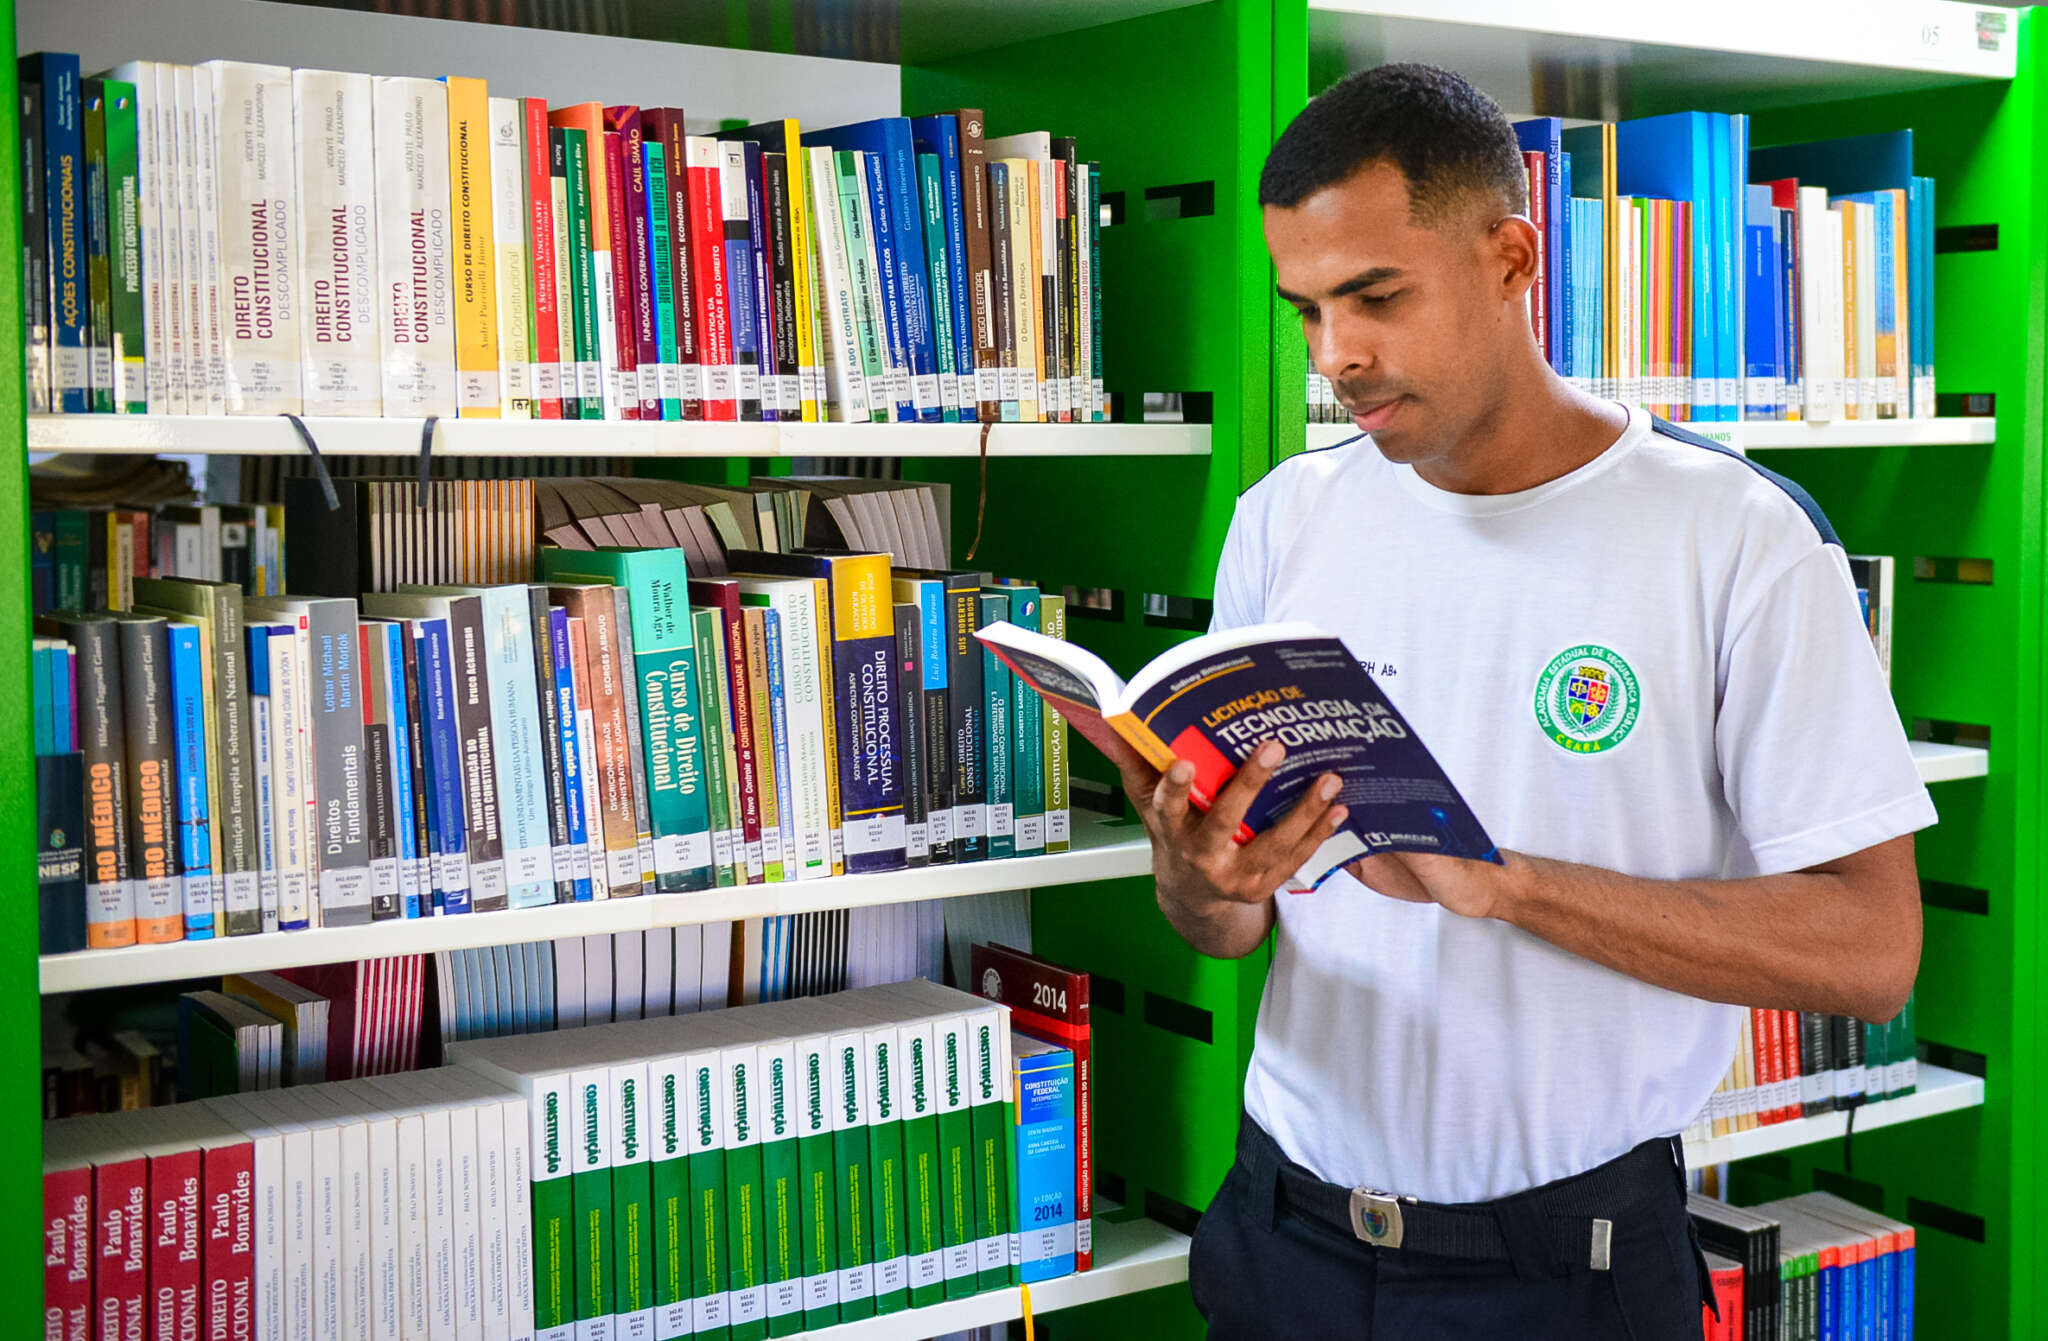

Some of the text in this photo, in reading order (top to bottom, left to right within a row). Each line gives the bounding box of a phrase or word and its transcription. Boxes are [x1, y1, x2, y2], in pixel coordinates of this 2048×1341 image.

[243, 99, 253, 162] VICENTE PAULO
[255, 83, 266, 180] MARCELO ALEXANDRINO
[325, 107, 334, 168] VICENTE PAULO
[335, 90, 346, 186] MARCELO ALEXANDRINO
[629, 129, 640, 164] SIMÃO
[459, 120, 474, 303] CURSO DE DIREITO CONSTITUCIONAL
[872, 156, 884, 191] Sundfeld
[61, 155, 78, 327] AÇÕES CONSTITUCIONAIS
[123, 175, 139, 293] PROCESSO CONSTITUCIONAL
[880, 208, 888, 233] Carlos
[252, 199, 273, 339] CONSTITUCIONAL
[274, 200, 291, 320] DESCOMPLICADO
[332, 204, 351, 342] CONSTITUCIONAL
[354, 205, 370, 323] DESCOMPLICADO
[411, 208, 429, 343] CONSTITUCIONAL
[431, 209, 446, 325] DESCOMPLICADO
[636, 217, 652, 341] FUNDAÇÕES GOVERNAMENTAIS
[675, 191, 693, 354] DIREITO CONSTITUCIONAL ECONÔMICO
[712, 246, 721, 280] DIREITO
[715, 283, 721, 295] DO
[233, 275, 252, 340] DIREITO
[315, 280, 331, 343] DIREITO
[393, 282, 410, 343] DIREITO
[708, 298, 718, 364] GRAMÁTICA DA
[718, 304, 726, 365] ONSTITUIÇÃO
[784, 280, 795, 364] Democracia Deliberativa
[884, 248, 903, 360] ADMINISTRATIVO PARA CÉTICOS
[975, 270, 988, 349] CÓDIGO ELEITORAL
[732, 620, 742, 660] MUNICIPAL
[787, 593, 803, 704] CURSO DE DIREITO
[798, 593, 814, 703] CONSTITUCIONAL
[958, 597, 967, 655] LUÍS ROBERTO
[966, 596, 975, 633] BARROSO
[223, 652, 237, 700] Nacional
[321, 635, 335, 712] Lothar Michael
[338, 633, 352, 708] Martin Morlok
[464, 626, 479, 704] Bruce Ackerman
[598, 614, 613, 695] GEORGES ABBOUD
[1536, 677, 1551, 728] ACADEMIA
[1548, 647, 1588, 674] ESTADUAL
[1591, 648, 1603, 656] DE
[1606, 652, 1637, 704] SEGURANÇA
[226, 702, 240, 756] Soberania
[561, 687, 572, 727] Direito
[612, 708, 622, 744] JUDICIAL
[644, 669, 677, 792] Constitucional
[668, 660, 698, 795] Curso de Direito
[735, 664, 751, 748] CONSTITUCIONALIDADE
[849, 671, 860, 780] ASPECTOS CONTEMPORÂNEOS
[862, 663, 877, 784] CONSTITUCIONAL
[875, 650, 894, 795] DIREITO PROCESSUAL
[1202, 686, 1305, 729] LICITAÇÃO DE
[1216, 700, 1390, 744] TECNOLOGIA DA
[467, 739, 484, 832] TRANSFORMAÇÃO DO
[478, 726, 497, 840] DIREITO CONSTITUCIONAL
[564, 738, 575, 777] saúde
[603, 722, 617, 811] DISCRICIONARIEDADE
[616, 755, 630, 821] ADMINISTRATIVA
[743, 751, 751, 760] de
[743, 762, 754, 793] Controle
[964, 706, 974, 794] CONSTITUCIONAL
[1051, 730, 1062, 805] CONSTITUIÇÃO
[90, 763, 115, 847] MÉDICO
[140, 760, 164, 844] MÉDICO
[326, 799, 342, 854] Direitos
[342, 745, 361, 844] Fundamentais
[746, 796, 755, 815] Novo
[38, 862, 79, 878] NESP
[232, 815, 245, 872] nstituição
[1032, 982, 1068, 1014] 2014
[772, 1057, 787, 1135] CONSTITUIÇÃO
[808, 1052, 823, 1130] CONSTITUIÇÃO
[844, 1046, 858, 1123] CONSTITUIÇÃO
[877, 1042, 892, 1119] CONSTITUIÇÃO
[912, 1037, 927, 1113] CONSTITUIÇÃO
[946, 1032, 961, 1107] CONSTITUIÇÃO
[979, 1025, 993, 1099] CONSTITUIÇÃO
[1024, 1076, 1069, 1091] CONSTITUIÇÃO
[1033, 1086, 1060, 1096] FEDERAL
[1081, 1081, 1087, 1091] DO
[546, 1091, 562, 1174] CONSTITUIÇÃO
[586, 1084, 602, 1165] CONSTITUIÇÃO
[623, 1078, 638, 1159] CONSTITUIÇÃO
[664, 1074, 678, 1154] CONSTITUIÇÃO
[699, 1067, 714, 1146] CONSTITUIÇÃO
[734, 1063, 748, 1142] CONSTITUIÇÃO
[1082, 1160, 1088, 1168] DA
[46, 1218, 66, 1267] Paulo
[68, 1194, 88, 1282] Bonavides
[103, 1209, 122, 1257] Paulo
[124, 1186, 143, 1272] Bonavides
[158, 1200, 177, 1247] Paulo
[179, 1177, 198, 1263] Bonavides
[211, 1193, 230, 1240] Paulo
[232, 1171, 250, 1255] Bonavides
[1034, 1202, 1063, 1222] 2014
[212, 1279, 227, 1339] DIREITO
